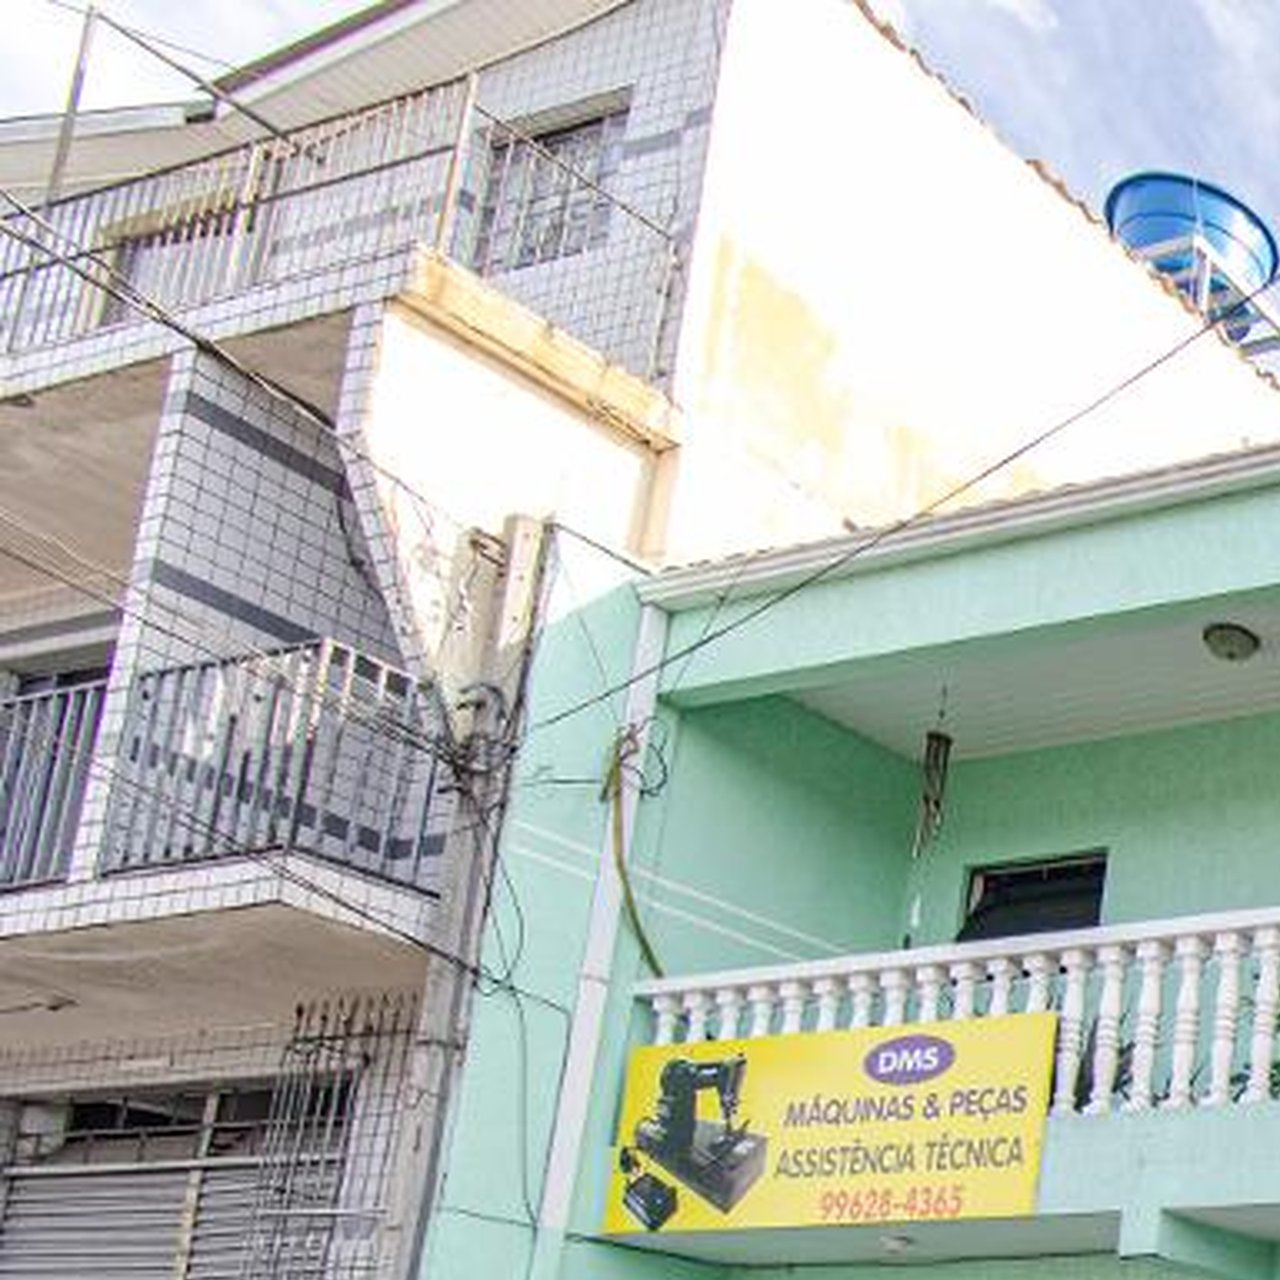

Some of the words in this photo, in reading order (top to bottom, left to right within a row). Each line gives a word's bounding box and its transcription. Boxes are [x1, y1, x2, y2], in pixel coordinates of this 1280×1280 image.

[878, 1047, 940, 1074] DMS
[783, 1094, 914, 1128] MÁQUINAS
[922, 1092, 941, 1119] &
[949, 1086, 1028, 1122] PEÇAS
[774, 1138, 916, 1179] ASSISTÊNCIA
[925, 1133, 1023, 1172] TÉCNICA
